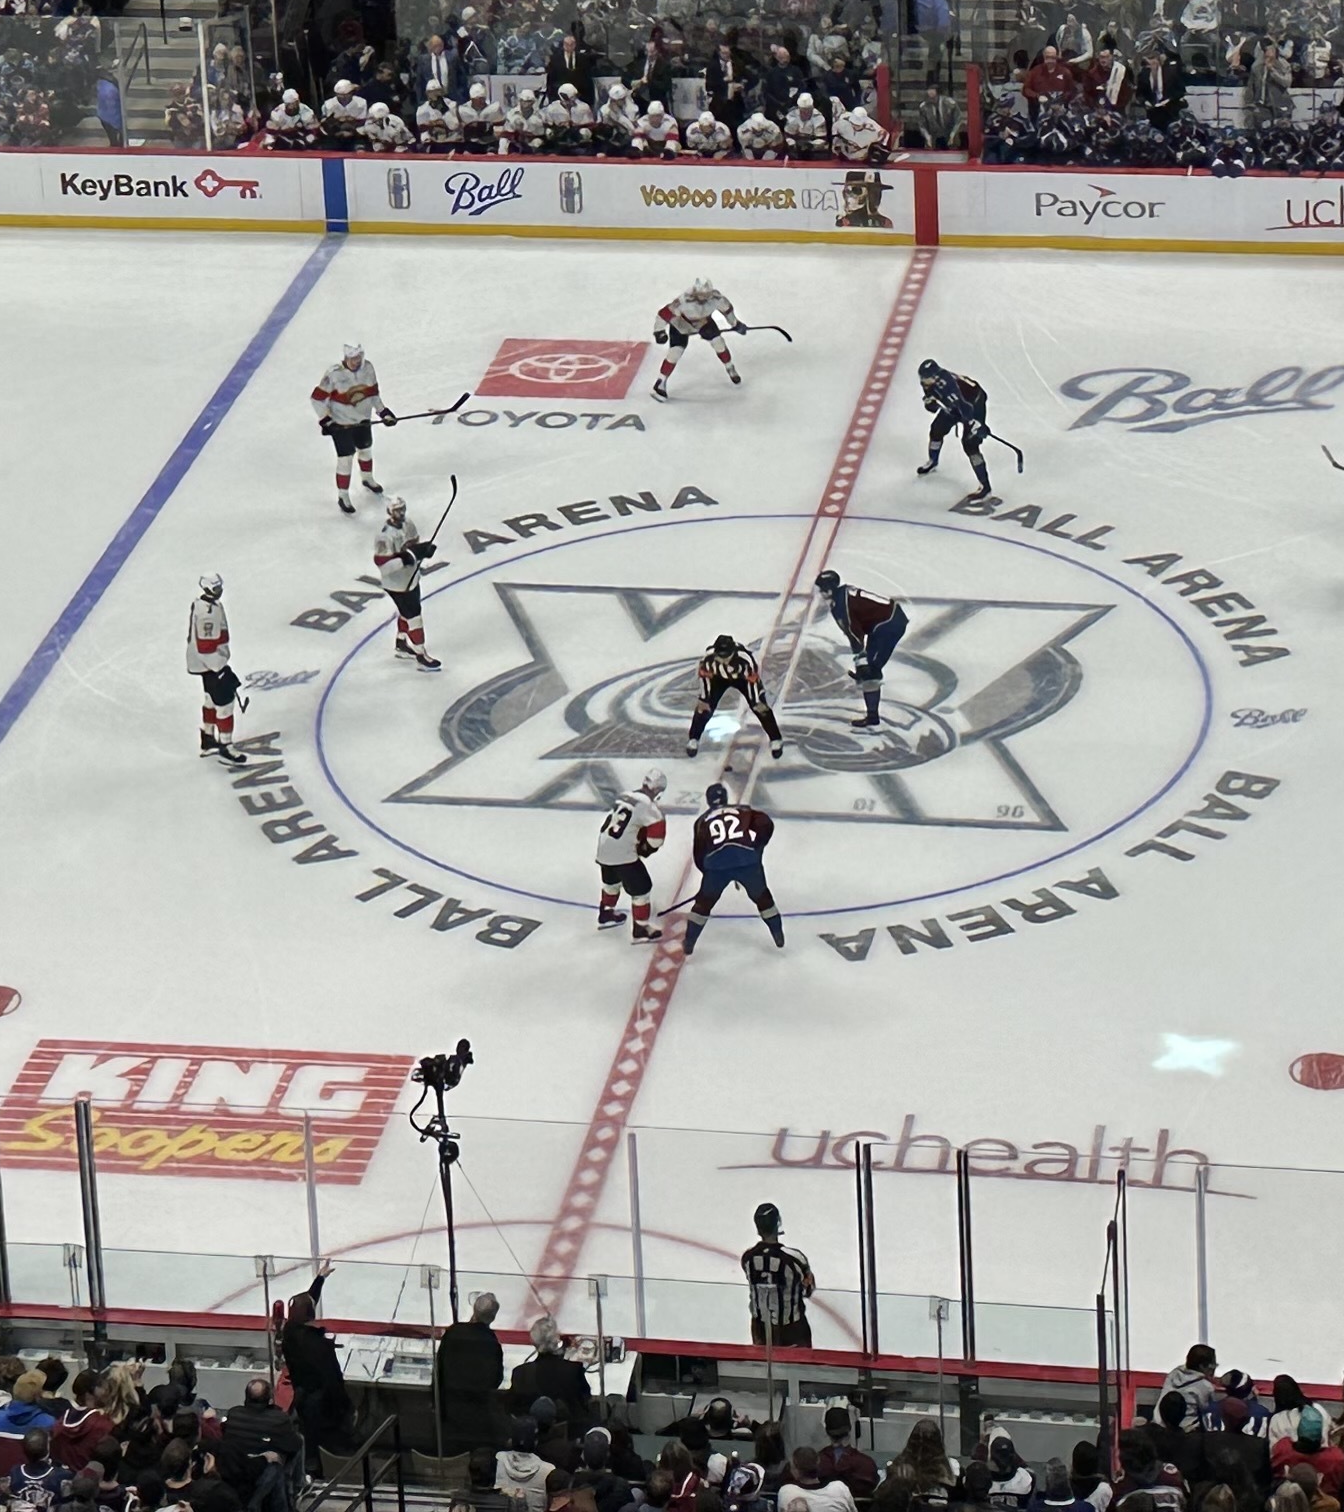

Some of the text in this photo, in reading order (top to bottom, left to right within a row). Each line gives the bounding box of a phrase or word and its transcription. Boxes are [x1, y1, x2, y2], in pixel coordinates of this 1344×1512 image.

[60, 172, 189, 201] KeyBank
[444, 167, 525, 216] Ball
[640, 184, 839, 211] VOODOO RANGER IPA
[1034, 192, 1166, 226] Paycor
[429, 407, 646, 432] TOYOTA
[463, 486, 719, 554] ARENA
[949, 495, 1291, 668] BALL ARENA
[227, 730, 543, 949] BALL ARENA
[709, 815, 744, 845] 92
[818, 770, 1281, 962] BALL ARENA
[37, 1052, 369, 1120] KING
[2, 1104, 355, 1170] Soopers
[772, 1114, 1213, 1190] uchealth
